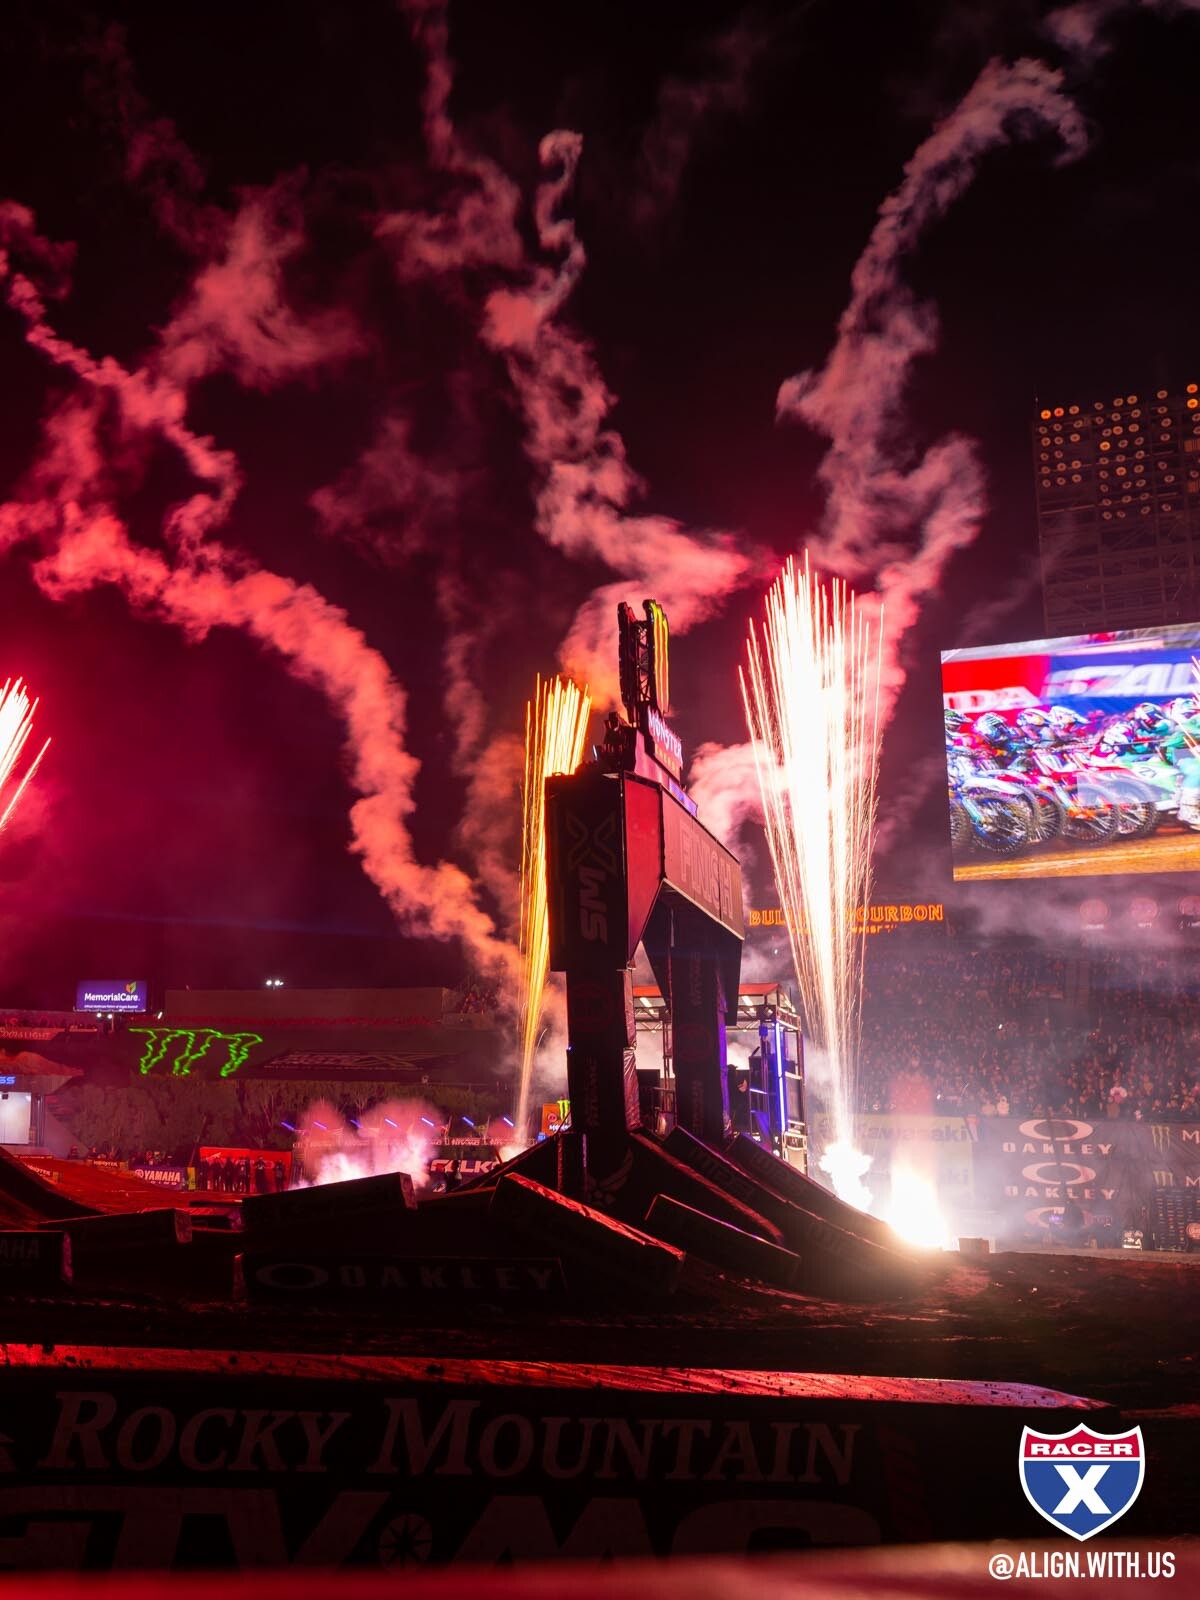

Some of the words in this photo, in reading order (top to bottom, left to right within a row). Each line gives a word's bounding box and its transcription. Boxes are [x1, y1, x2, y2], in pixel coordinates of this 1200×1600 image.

[843, 904, 945, 923] OURBON
[84, 992, 139, 1001] MemorialCare
[25, 1031, 51, 1040] LIGHT
[1002, 1141, 1113, 1155] OAKLEY
[143, 1168, 181, 1183] YAMAHA
[1005, 1186, 1115, 1200] OAKLEY
[337, 1263, 555, 1291] OAKLEY
[36, 1390, 353, 1473] ROCKY
[365, 1397, 863, 1486] MOUNTAIN
